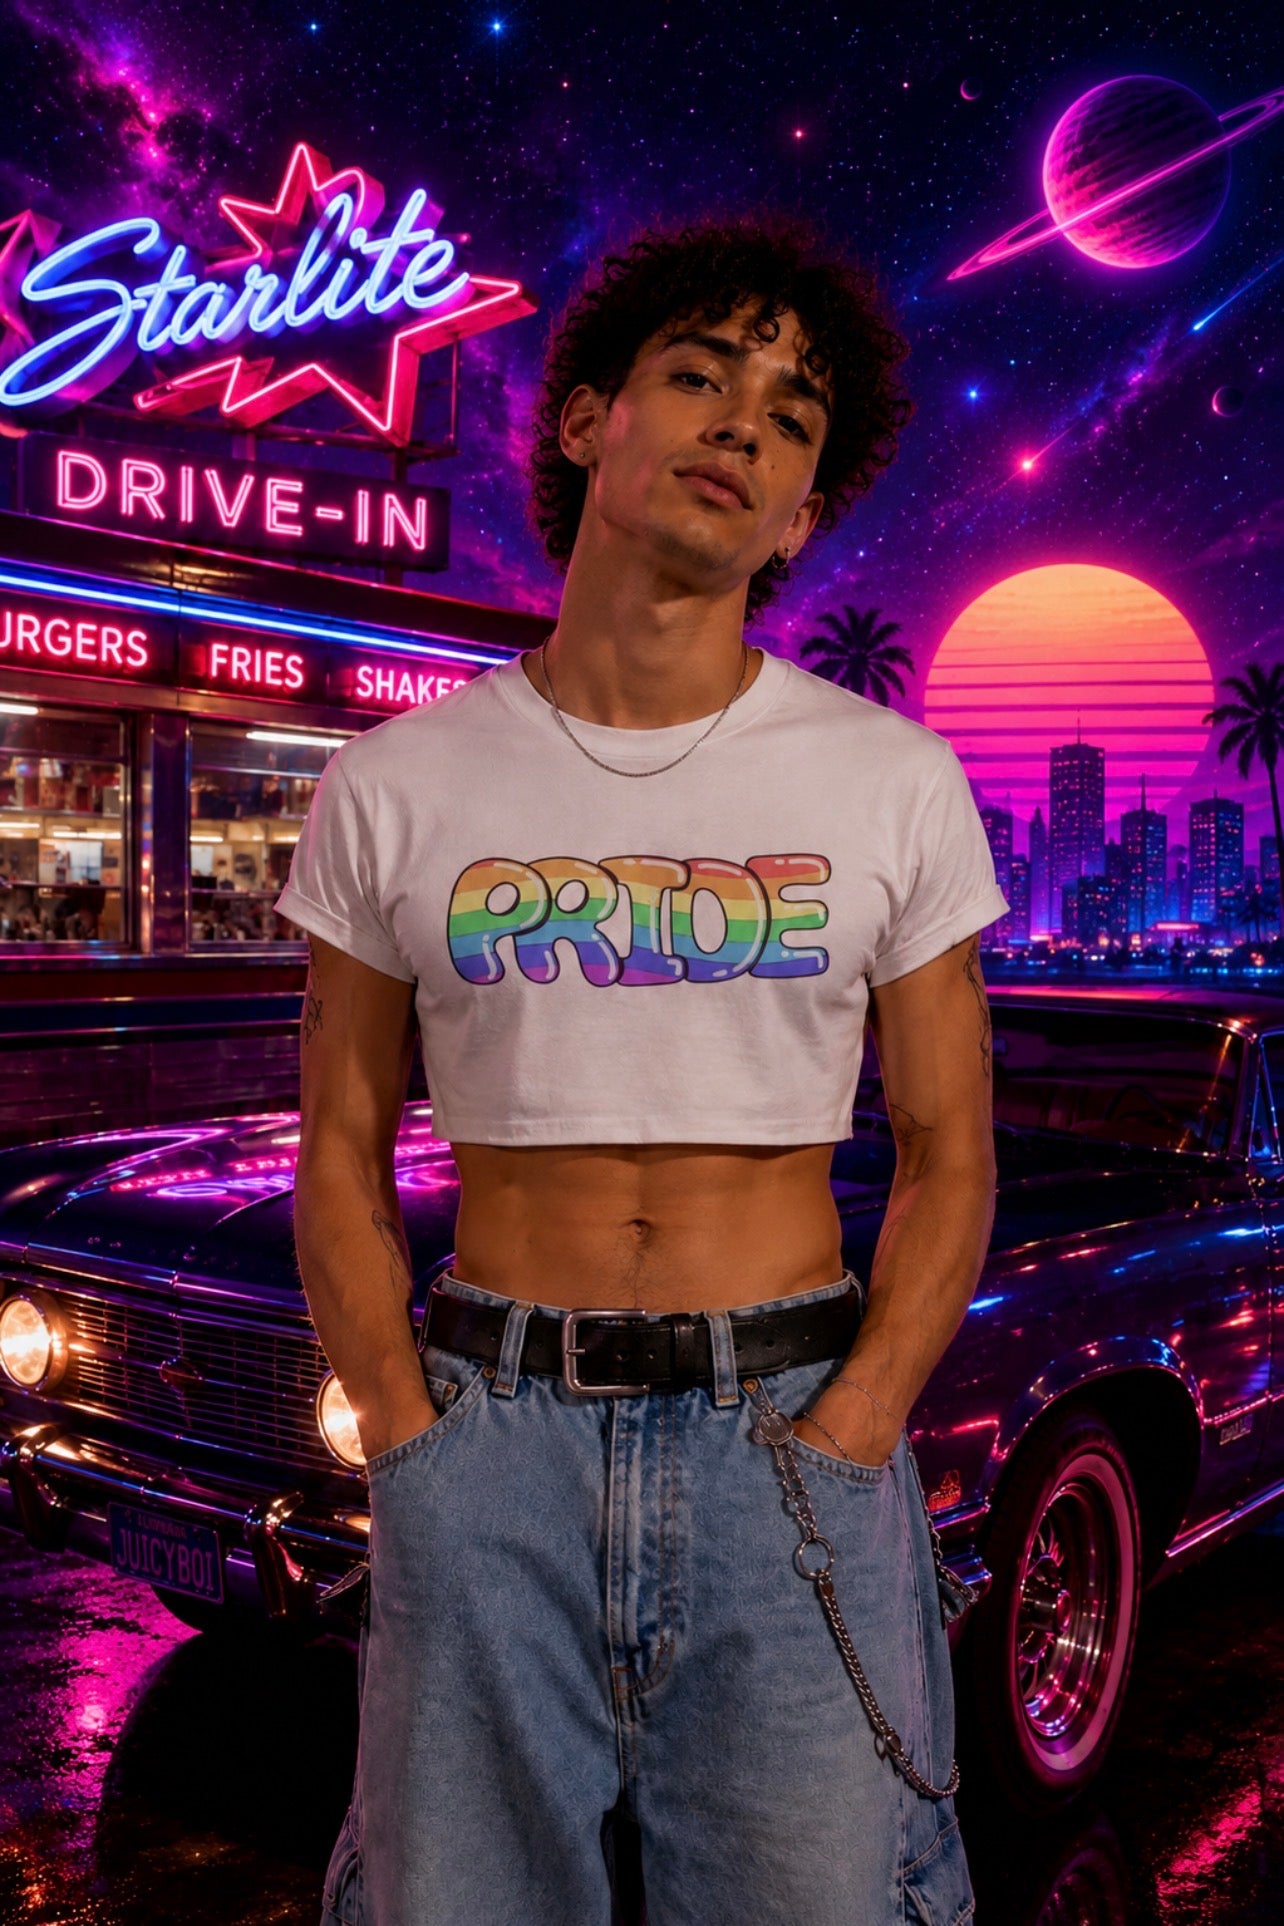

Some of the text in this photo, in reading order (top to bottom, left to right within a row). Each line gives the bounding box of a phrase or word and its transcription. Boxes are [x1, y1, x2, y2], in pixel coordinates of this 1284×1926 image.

[0, 188, 470, 406] Starlite
[56, 449, 428, 551] DRIVE-IN
[210, 643, 305, 689] FRIES
[447, 853, 832, 987] PRIDE
[116, 1528, 213, 1591] JUICYBOI
